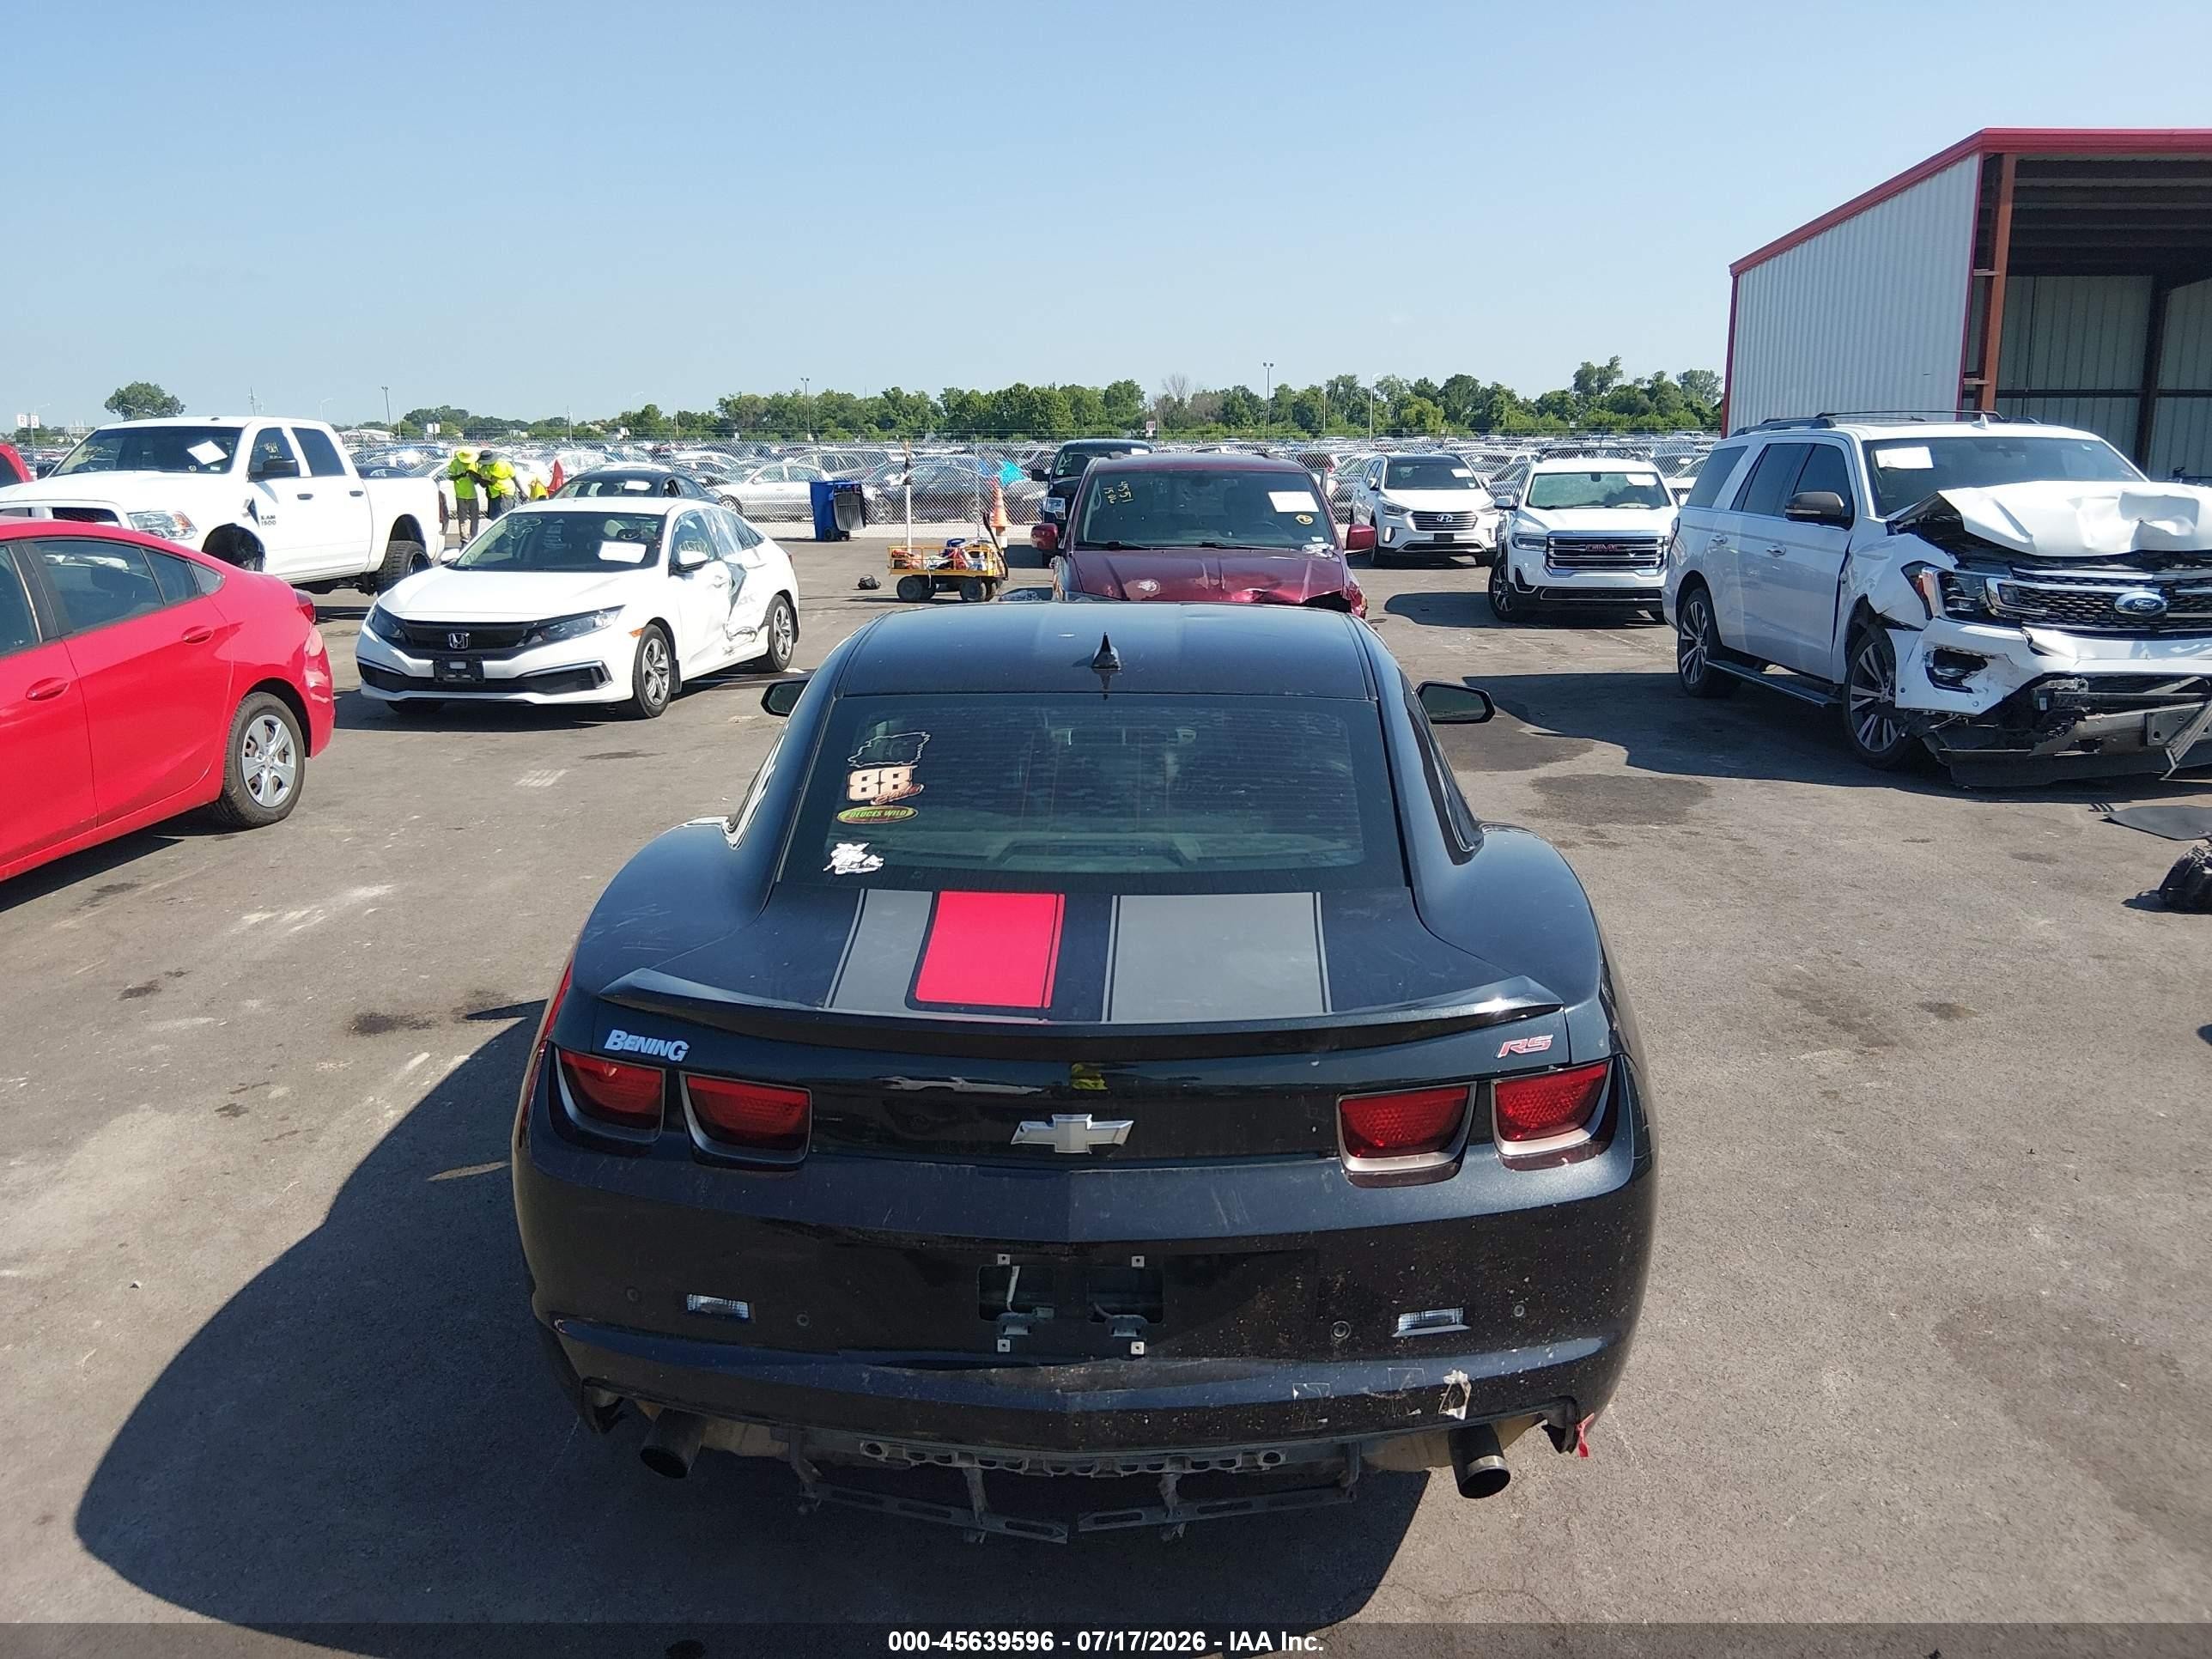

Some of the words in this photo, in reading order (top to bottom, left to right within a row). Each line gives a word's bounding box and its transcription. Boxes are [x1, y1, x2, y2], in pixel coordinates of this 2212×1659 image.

[1586, 544, 1626, 552] GMC
[848, 766, 917, 800] 88
[1497, 1034, 1554, 1059] RS
